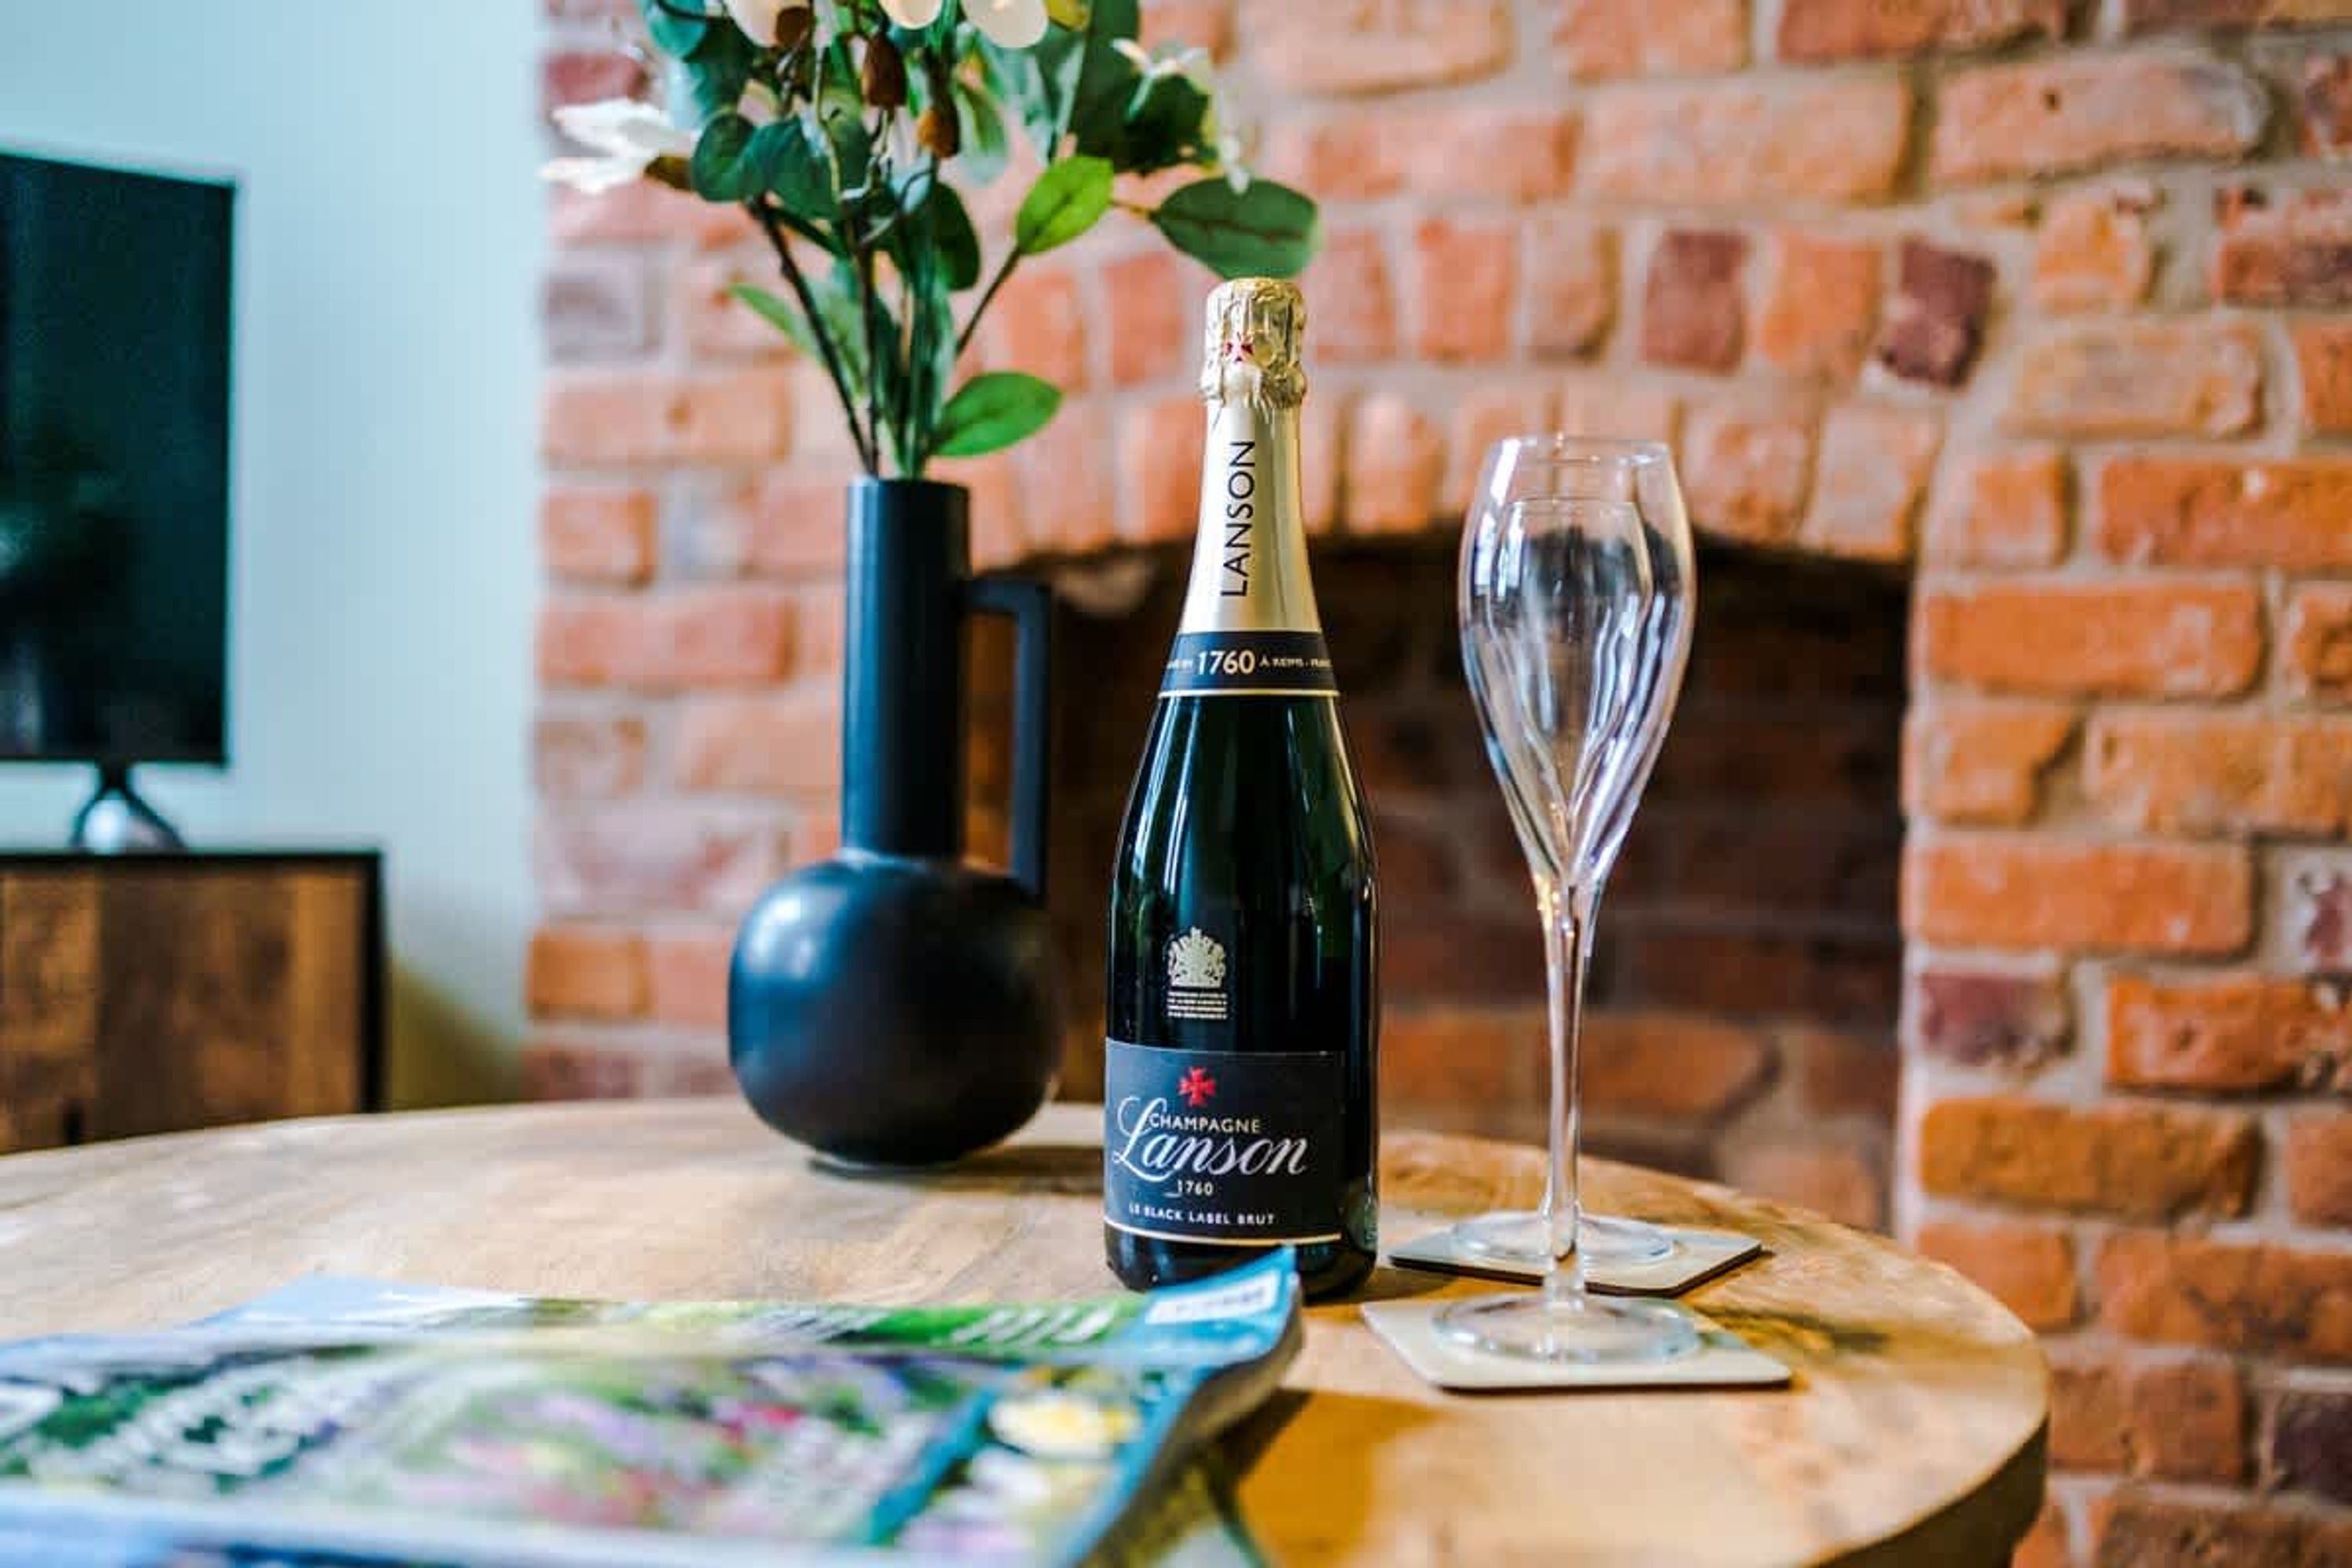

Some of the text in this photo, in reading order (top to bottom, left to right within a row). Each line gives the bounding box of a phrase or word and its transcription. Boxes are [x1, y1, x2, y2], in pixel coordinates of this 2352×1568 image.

[1221, 441, 1256, 597] LANSON
[1198, 649, 1255, 676] 1760
[1149, 1113, 1261, 1134] CHAMPAGNE
[1111, 1095, 1308, 1182] Lanson
[1178, 1180, 1214, 1196] 1760
[1144, 1205, 1184, 1221] BLACK
[1189, 1210, 1230, 1225] LABEL
[1237, 1213, 1275, 1226] BRUT
